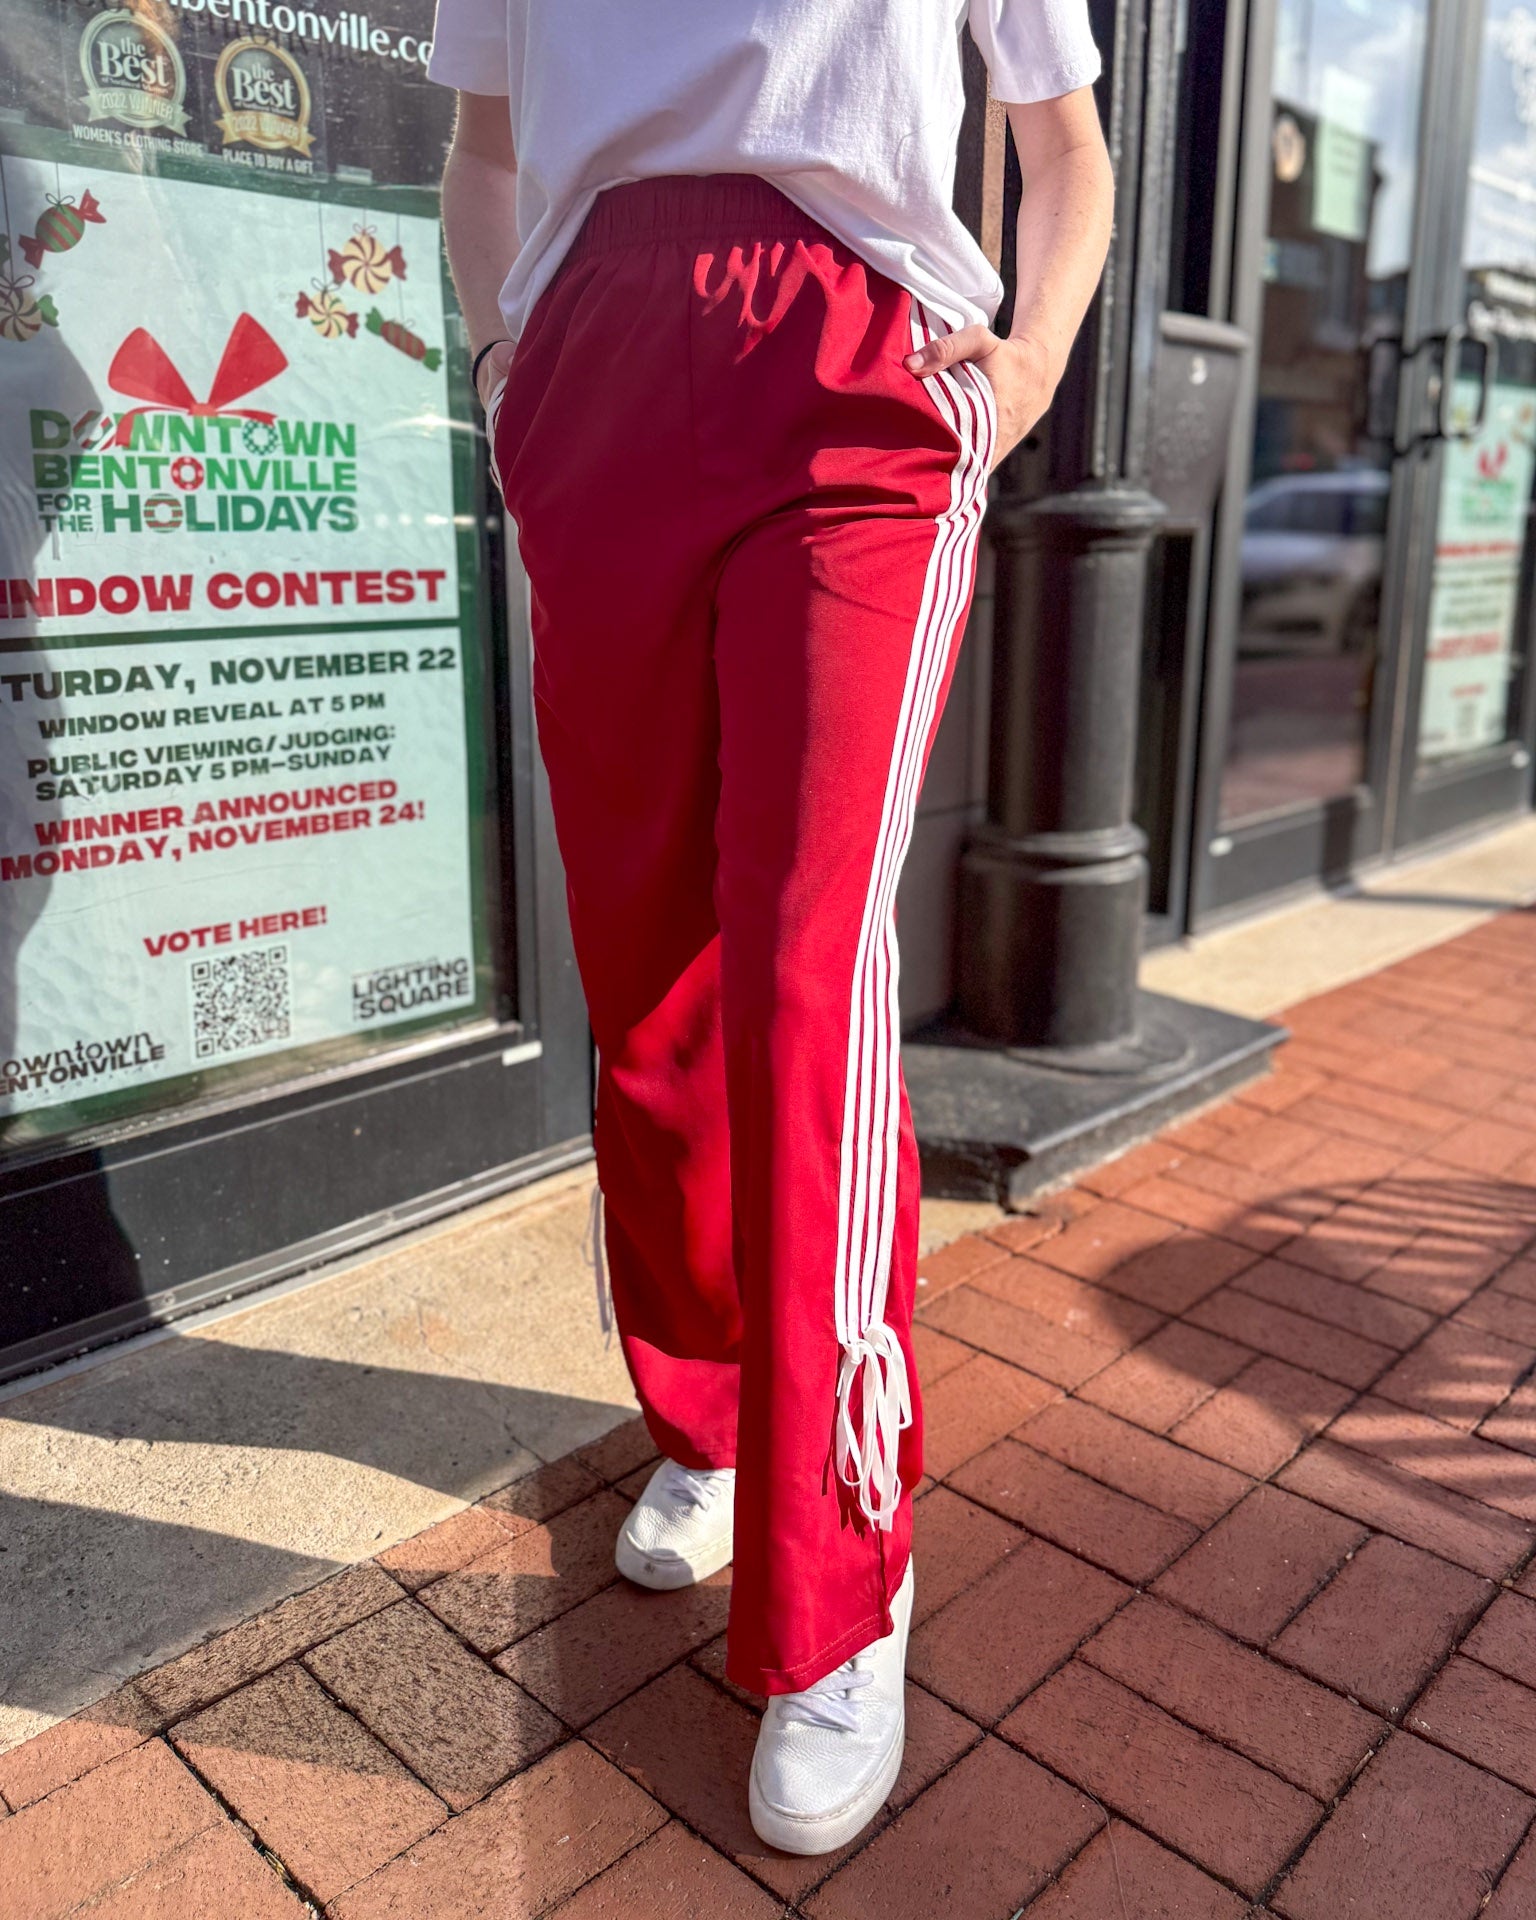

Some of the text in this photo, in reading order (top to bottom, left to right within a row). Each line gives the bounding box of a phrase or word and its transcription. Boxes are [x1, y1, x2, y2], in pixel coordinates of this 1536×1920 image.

[97, 41, 170, 87] Best
[120, 37, 146, 57] the
[231, 67, 297, 110] Best
[251, 62, 275, 82] the
[99, 92, 174, 120] 2022 WINNER
[72, 123, 206, 157] WOMEN'S CLOTHING STORE
[222, 148, 314, 174] PLACE TO BUY A GIFT
[29, 409, 356, 458] DOWNTOWN
[33, 453, 357, 492] BENTONVILLE
[37, 493, 92, 513] FOR
[101, 493, 359, 534] HOLIDAYS
[206, 570, 446, 610] CONTEST
[1, 648, 457, 702] TURDAY, NOVEMBER 22
[38, 692, 386, 739] WINDOW REVEAL AT 5 PM
[27, 749, 139, 779] PUBLIC
[35, 764, 204, 802] SATURDAY
[210, 762, 226, 780] 5
[34, 779, 398, 847] WINNER ANNOUNCED
[0, 800, 426, 881] MONDAY, NOVEMBER 24!
[143, 904, 328, 958] VOTE HERE!
[353, 957, 469, 999] LIGHTING
[360, 977, 469, 1020] SQUARE
[2, 1031, 153, 1078] owntown
